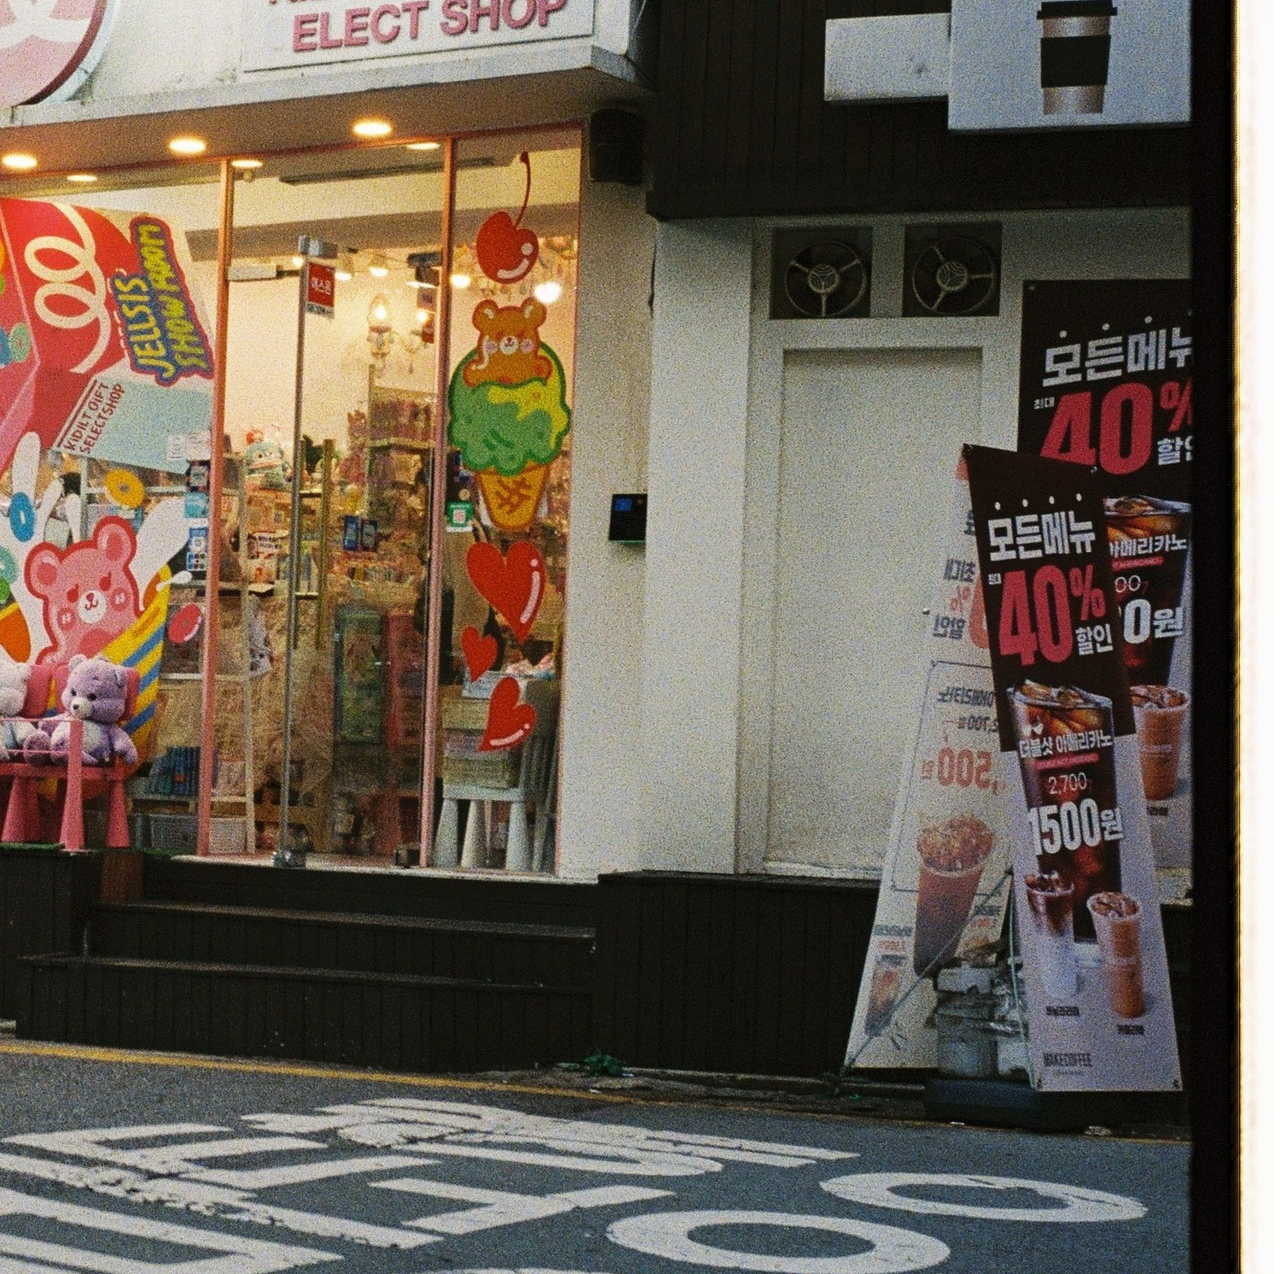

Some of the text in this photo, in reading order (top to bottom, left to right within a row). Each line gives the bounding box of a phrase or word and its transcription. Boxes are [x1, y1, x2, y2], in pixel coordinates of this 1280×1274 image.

[293, 0, 429, 53] ELECT
[1040, 379, 1193, 475] 40%
[987, 510, 1096, 562] 모든메뉴
[998, 565, 1107, 667] 40%
[1075, 623, 1114, 656] 할인
